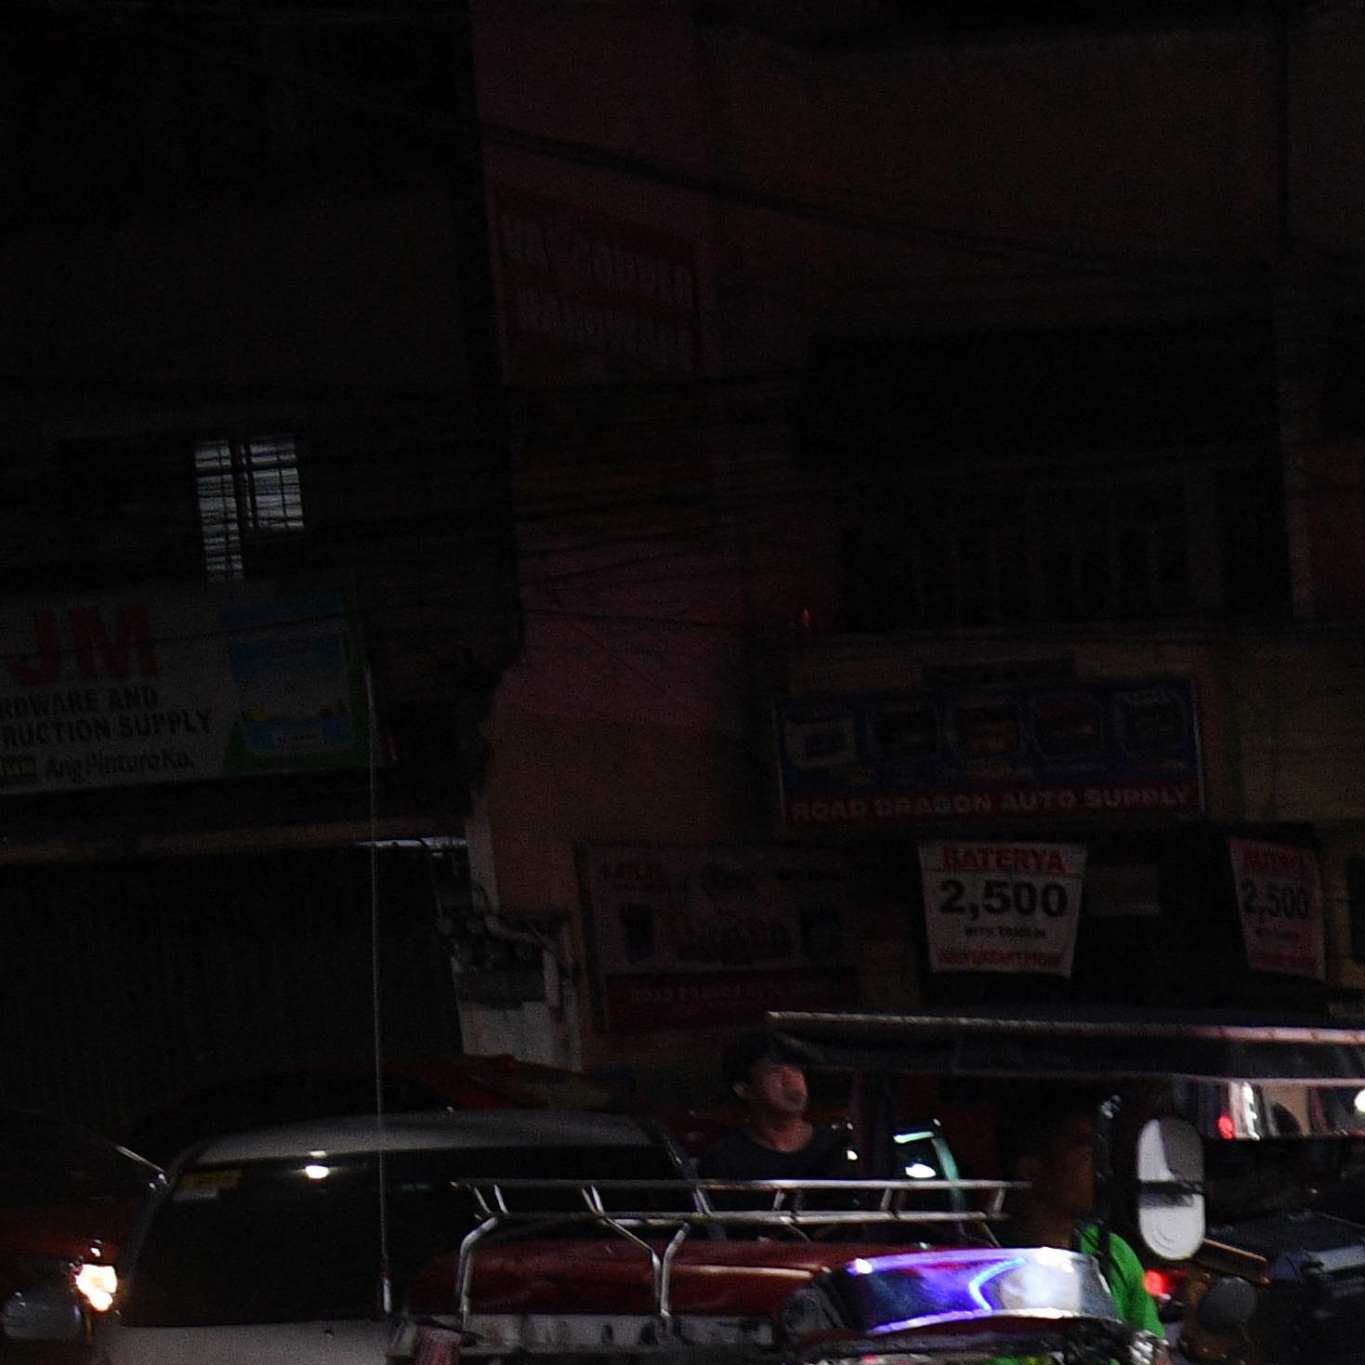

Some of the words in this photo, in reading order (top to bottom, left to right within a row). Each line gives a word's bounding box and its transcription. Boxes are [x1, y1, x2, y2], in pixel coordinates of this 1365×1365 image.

[7, 599, 161, 688] JM
[118, 709, 212, 740] SUPPLY
[1000, 789, 1076, 813] AUTO
[1084, 785, 1190, 810] SUPPLY
[943, 846, 1067, 874] BATERYA
[939, 878, 1068, 921] 2,500
